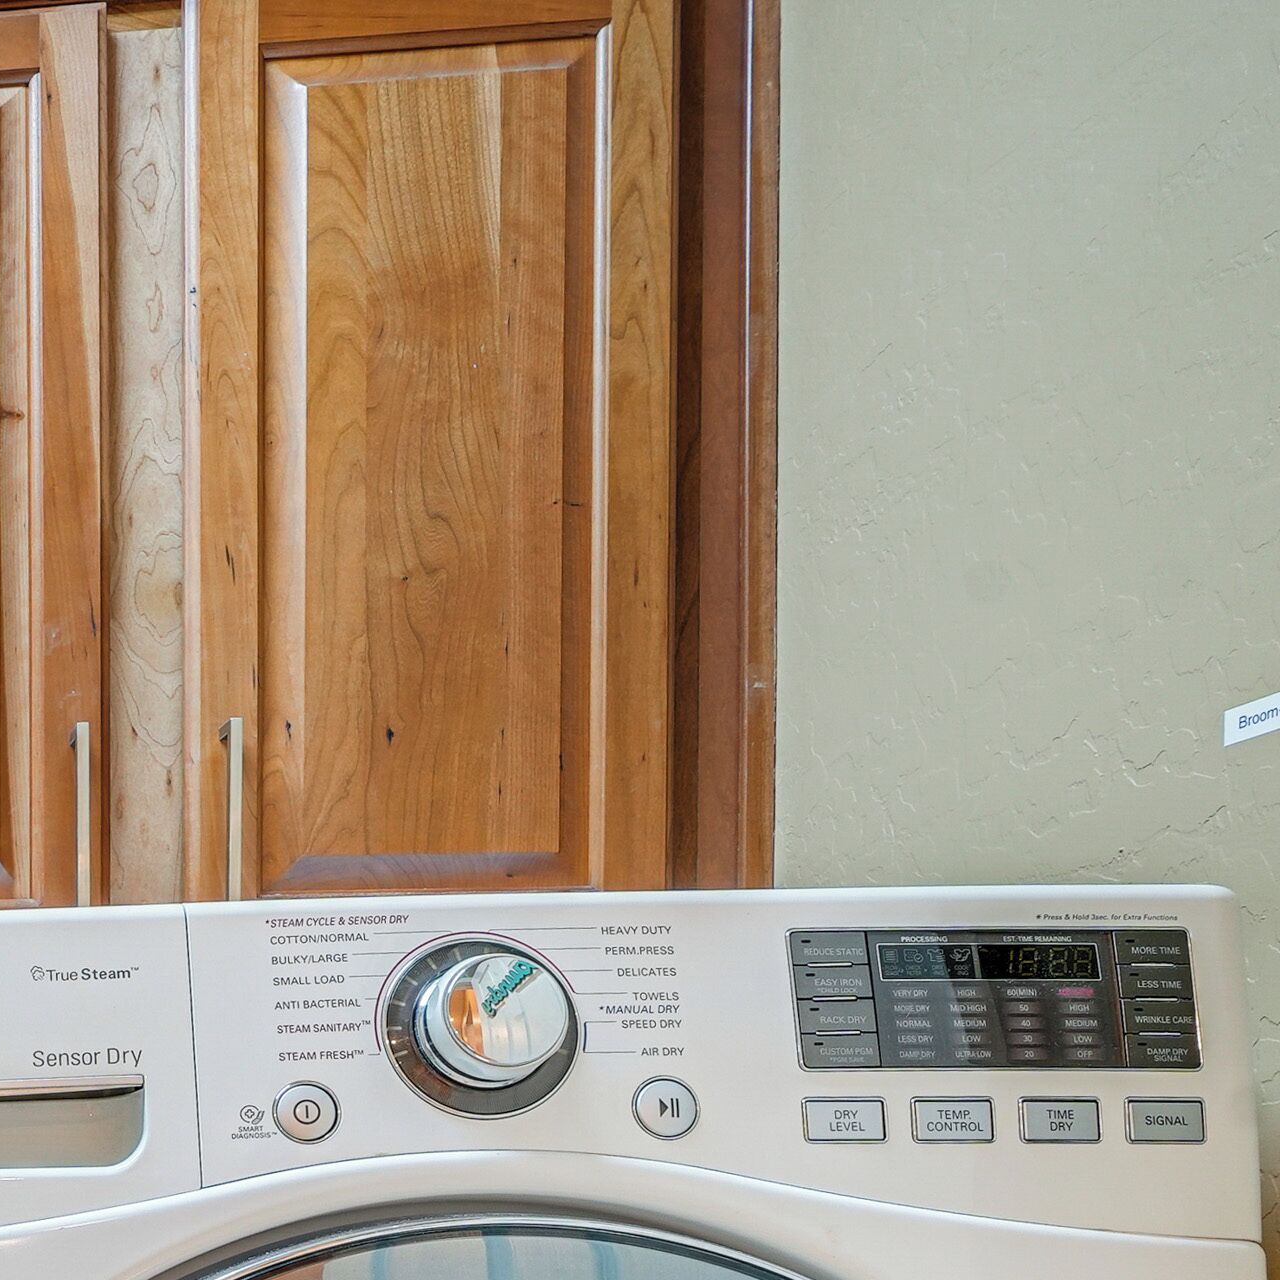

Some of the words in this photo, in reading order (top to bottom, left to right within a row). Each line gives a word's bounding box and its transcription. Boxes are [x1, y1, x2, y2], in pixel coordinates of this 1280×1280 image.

[1238, 708, 1280, 729] Broom
[306, 917, 336, 927] CYCLE
[338, 917, 346, 926] &
[347, 915, 387, 925] SENSOR
[389, 914, 409, 924] DRY
[601, 926, 638, 935] HEAVY
[642, 926, 672, 934] DUTY
[270, 933, 369, 945] COTTON/NORMAL
[804, 948, 834, 956] REDUCE
[836, 948, 864, 956] STATIC
[1131, 947, 1157, 955] MORE
[1160, 947, 1181, 955] TIME
[271, 953, 349, 965] BULKY/LARGE
[617, 967, 677, 977] DELICATES
[273, 976, 311, 986] SMALL
[314, 975, 345, 985] LOAD
[632, 992, 680, 1001] TOWELS
[958, 989, 976, 997] HIGH
[274, 1000, 300, 1010] ANTI
[303, 998, 361, 1009] BACTERIAL
[658, 1005, 680, 1014] DRY
[621, 1020, 657, 1029] SPEED
[660, 1020, 682, 1029] DRY
[820, 1016, 845, 1024] RACK
[848, 1016, 867, 1024] DRY
[896, 1020, 932, 1028] NORMAL
[1135, 1016, 1171, 1024] WRINKLE
[1173, 1016, 1193, 1024] CARE
[277, 1023, 311, 1034] STEAM
[278, 1052, 316, 1061] STEAM
[641, 1047, 659, 1056] AIR
[663, 1047, 685, 1056] DRY
[32, 1049, 101, 1068] Sensor
[107, 1047, 142, 1067] Dry
[834, 1110, 858, 1120] DRY
[937, 1110, 971, 1120] TEMP.
[1047, 1110, 1074, 1120] TIME
[1145, 1115, 1188, 1126] SIGNAL
[829, 1122, 866, 1132] LEVEL
[927, 1121, 984, 1132] CONTROL
[1050, 1121, 1074, 1132] DRY
